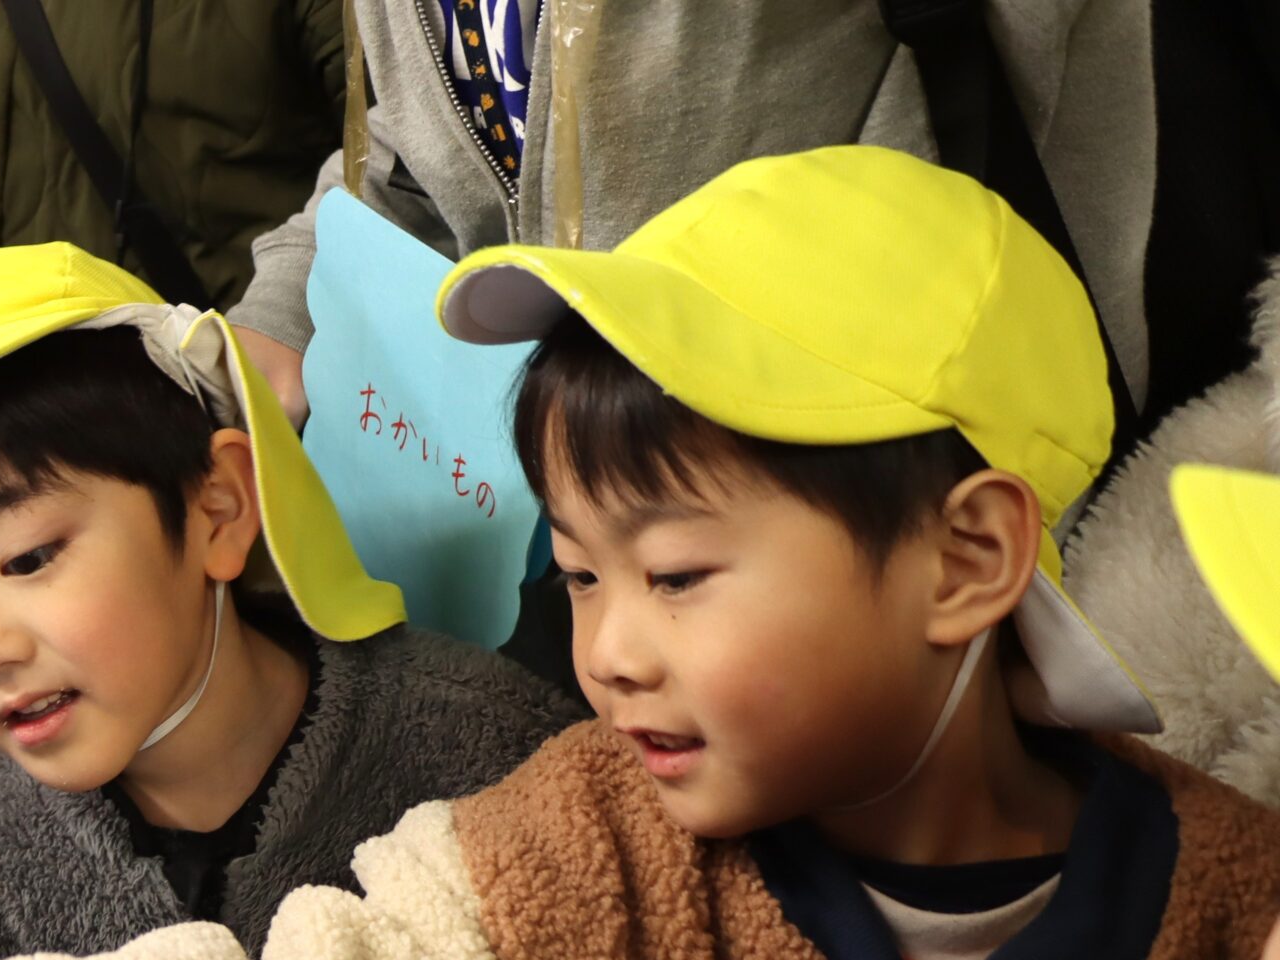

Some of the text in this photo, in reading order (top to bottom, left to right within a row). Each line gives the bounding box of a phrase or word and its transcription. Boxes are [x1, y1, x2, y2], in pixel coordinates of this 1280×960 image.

[359, 382, 496, 519] おかいもの
